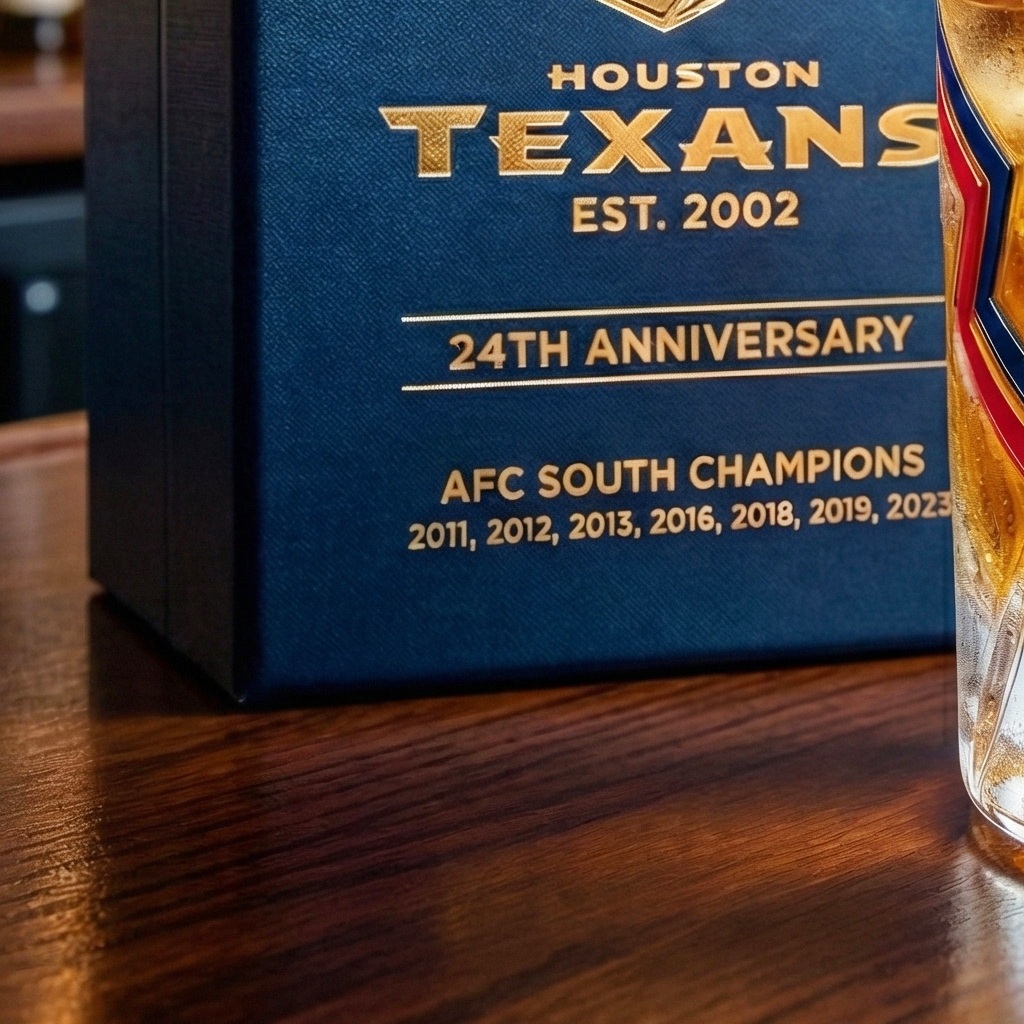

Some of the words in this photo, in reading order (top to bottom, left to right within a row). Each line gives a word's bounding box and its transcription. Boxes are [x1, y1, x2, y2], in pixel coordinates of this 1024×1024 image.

[548, 60, 820, 92] HOUSTON
[378, 103, 939, 178] TEXANS
[572, 196, 666, 233] EST.
[682, 191, 800, 230] 2002
[448, 330, 570, 371] 24TH
[585, 315, 914, 365] ANNIVERSARY
[439, 466, 526, 505] AFC
[537, 457, 676, 497] SOUTH
[688, 444, 926, 490] CHAMPIONS
[407, 521, 477, 552] 2011,
[486, 516, 560, 546] 2012,
[568, 511, 642, 541] 2013,
[648, 505, 722, 535] 2016,
[730, 500, 802, 530] 2018,
[809, 494, 880, 524] 2019,
[886, 491, 952, 520] 2023
